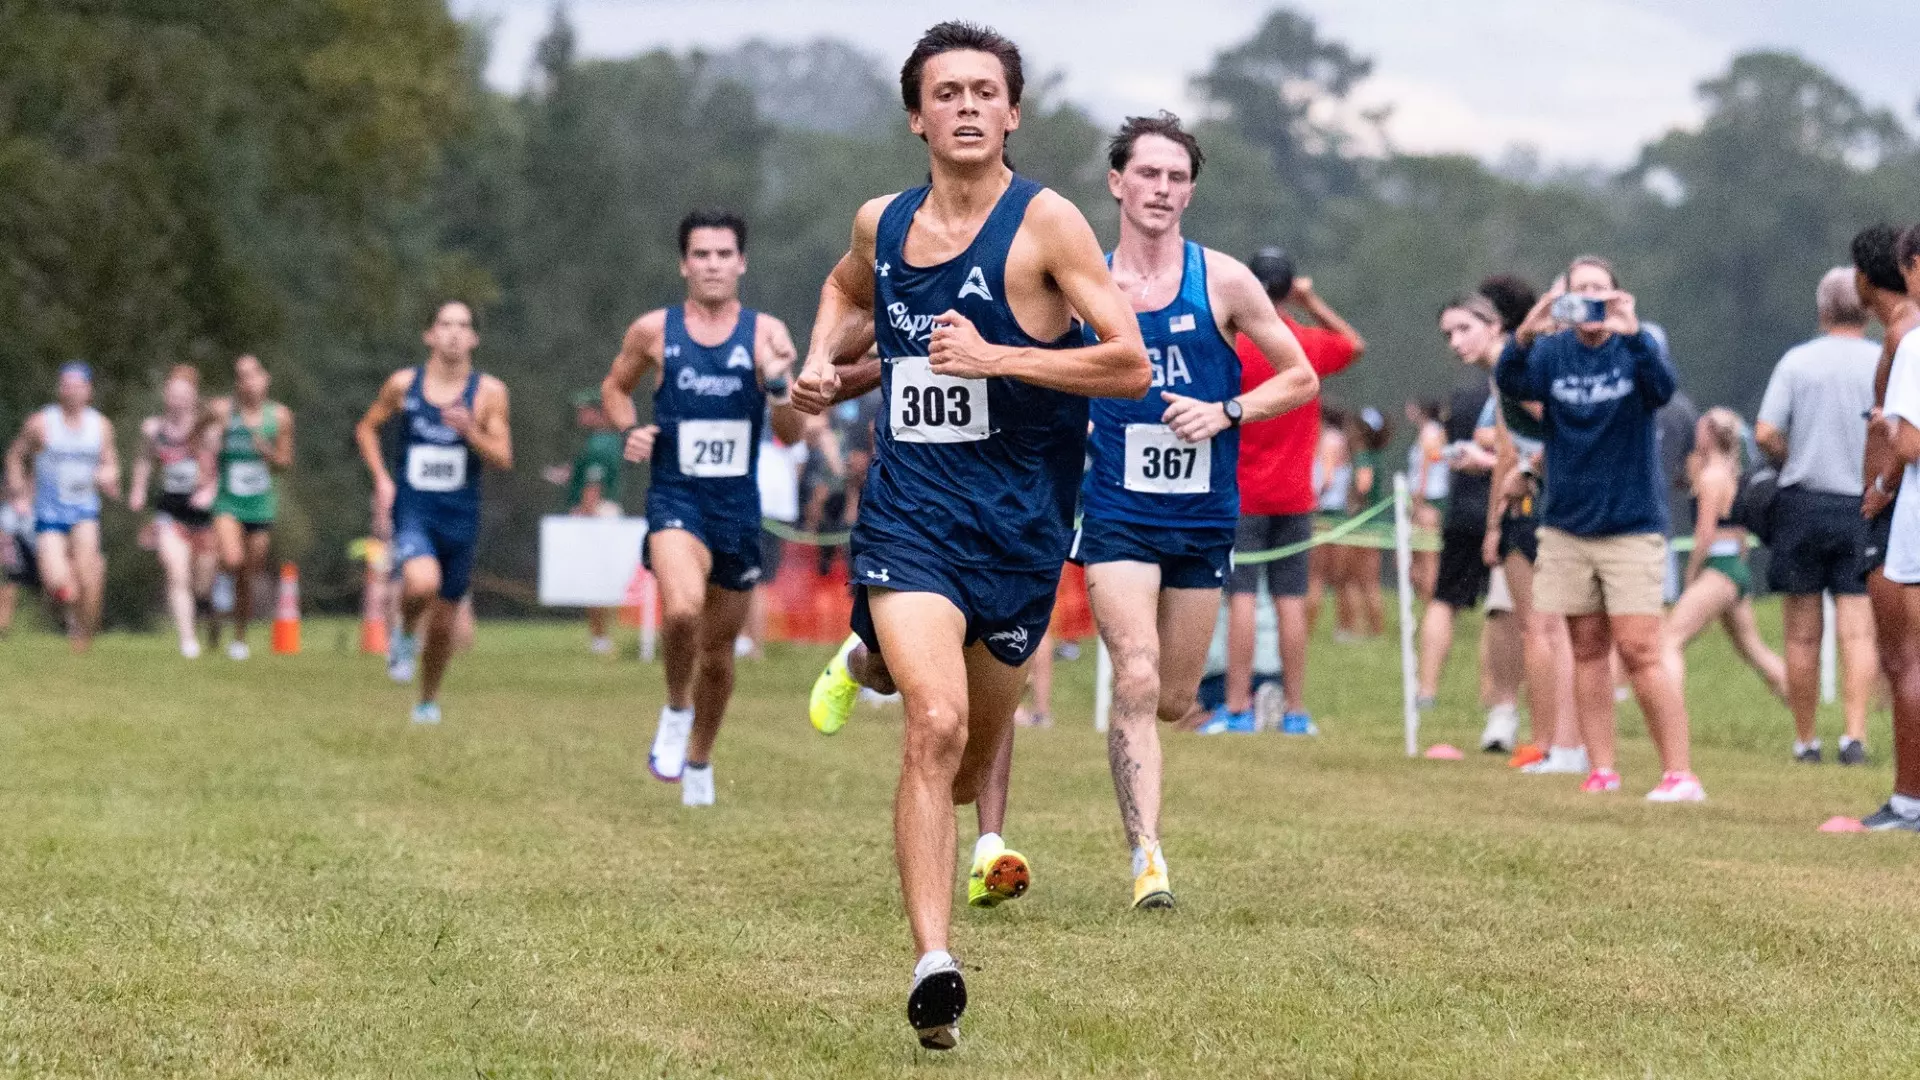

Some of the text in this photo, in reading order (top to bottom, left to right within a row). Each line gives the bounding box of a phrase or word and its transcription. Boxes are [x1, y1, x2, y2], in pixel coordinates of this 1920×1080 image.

[1148, 344, 1193, 388] SA
[902, 385, 972, 427] 303
[693, 440, 737, 465] 297
[1142, 447, 1197, 480] 367
